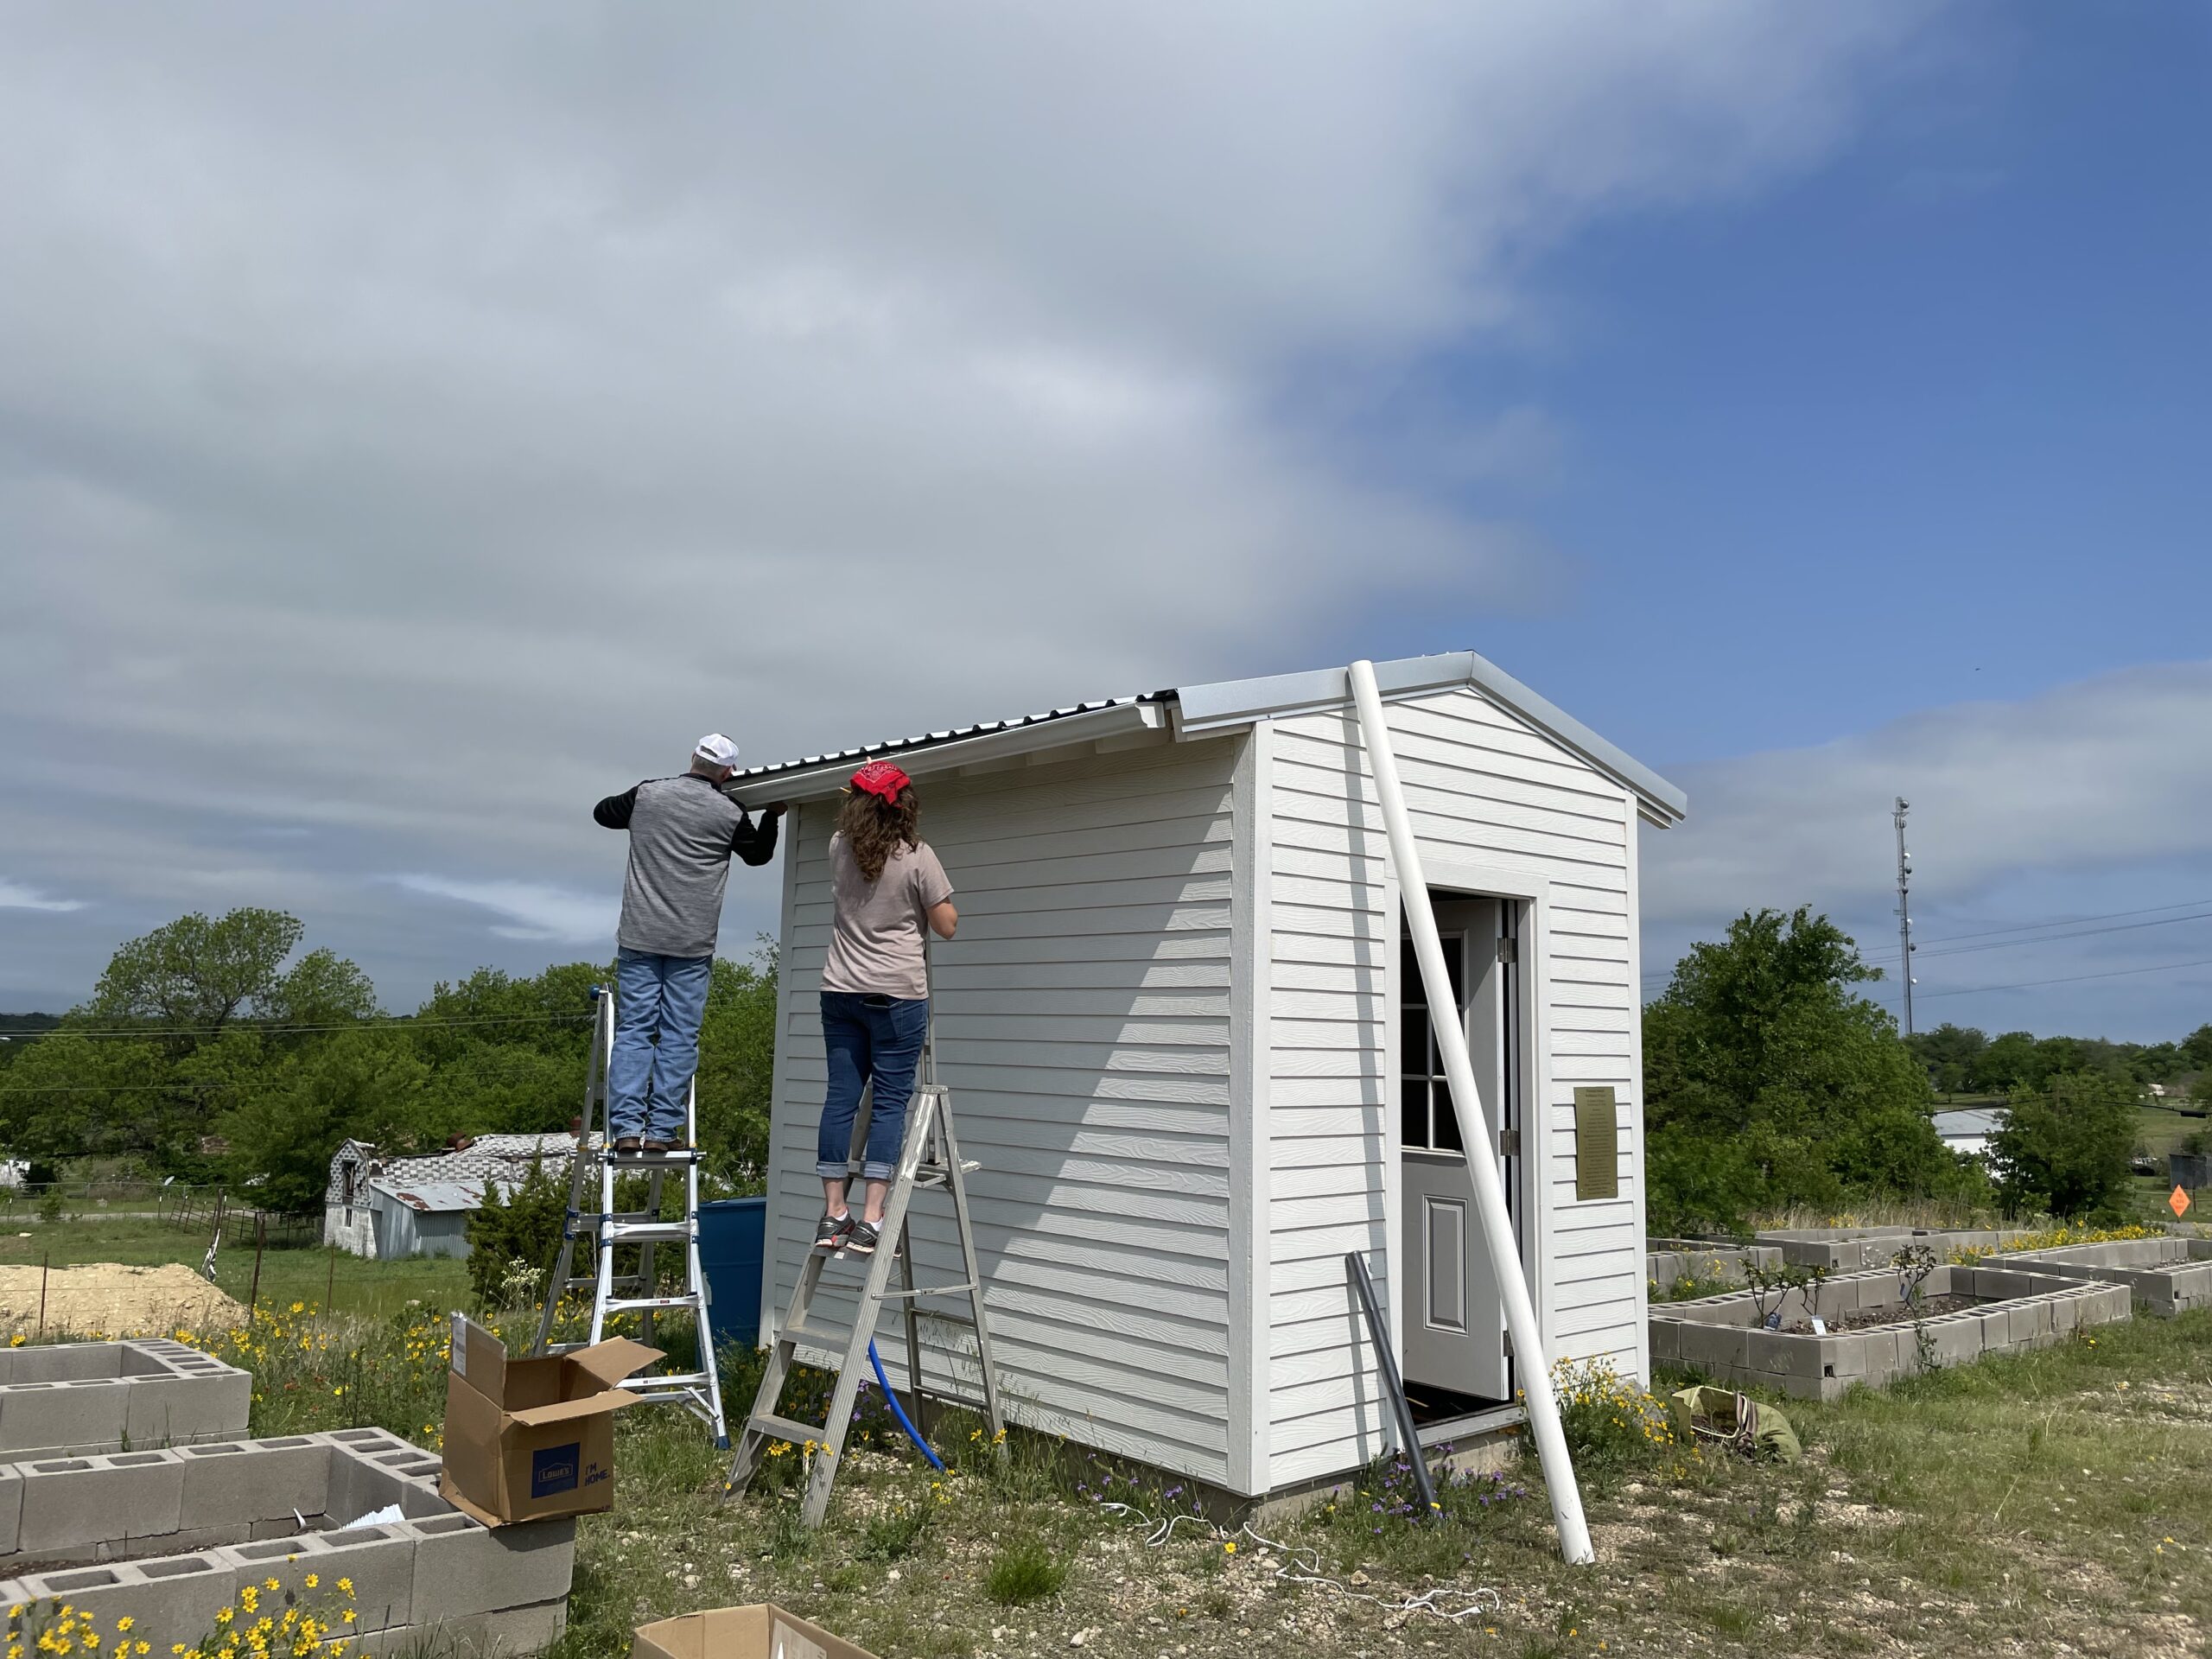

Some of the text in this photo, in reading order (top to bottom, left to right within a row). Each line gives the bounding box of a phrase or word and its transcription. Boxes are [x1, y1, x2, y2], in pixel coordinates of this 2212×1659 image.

[543, 1467, 569, 1479] LOWE'S
[585, 1462, 597, 1475] I'M
[584, 1469, 610, 1486] HOME.
